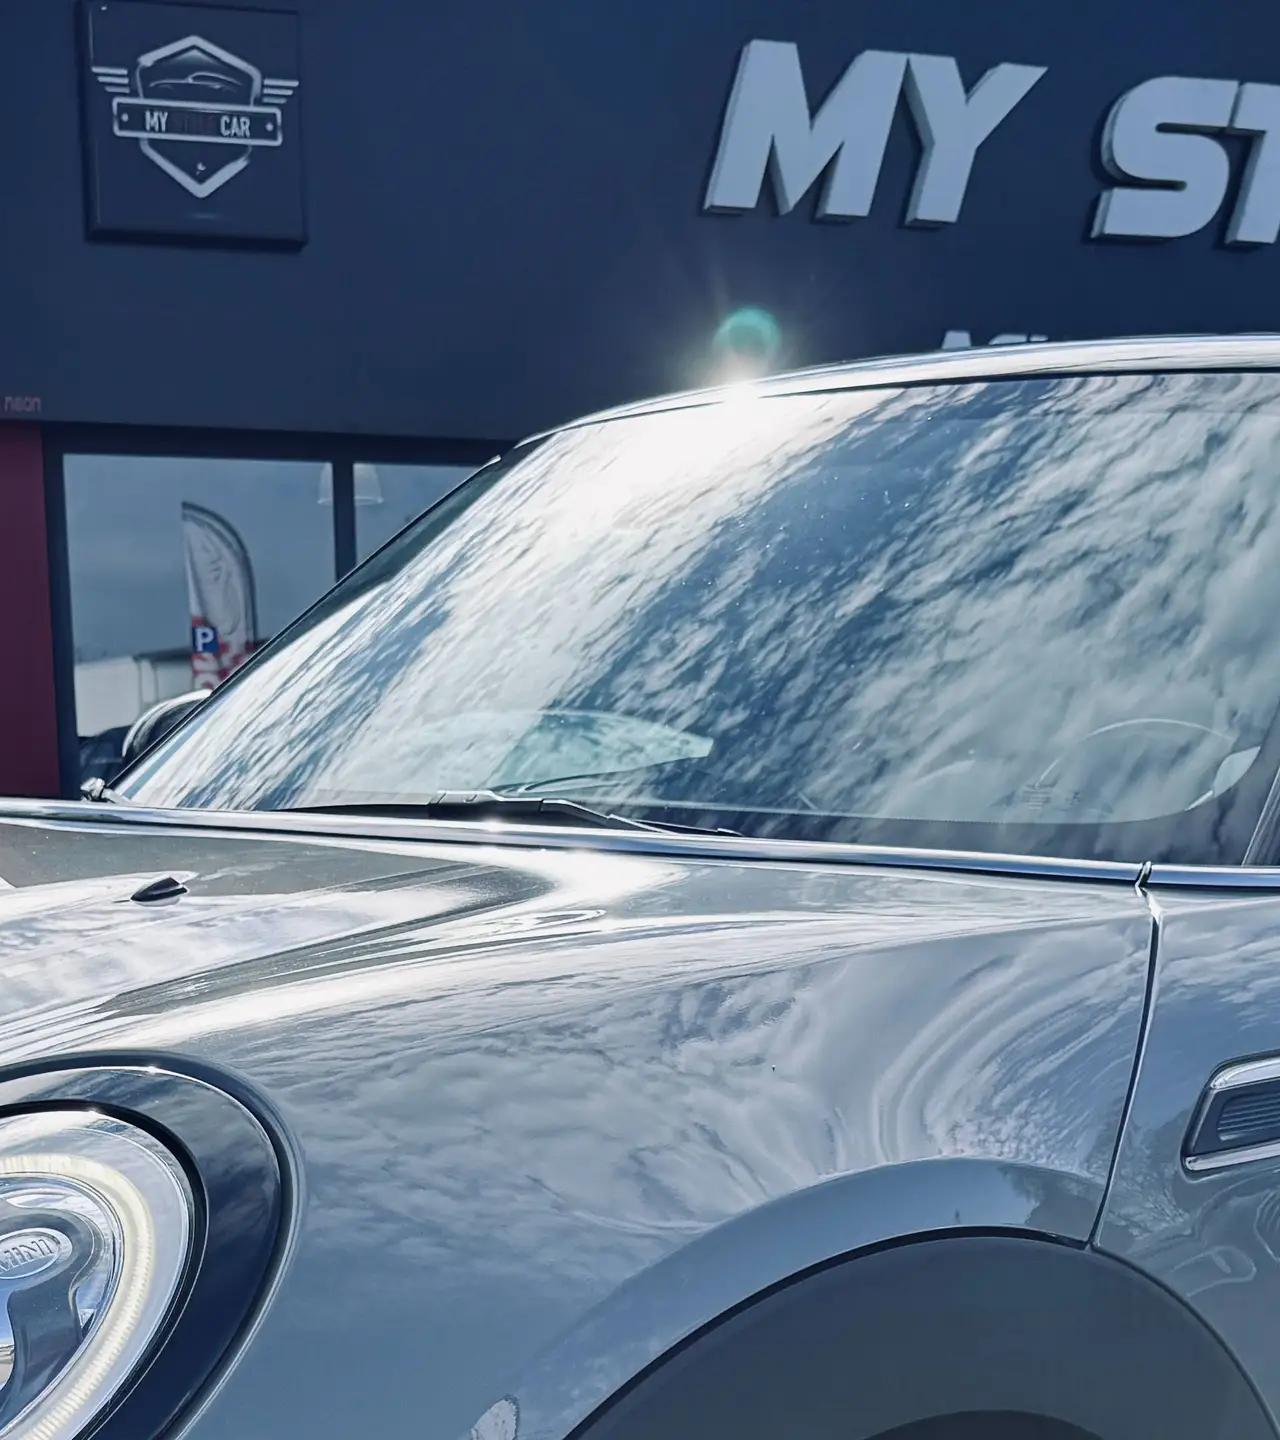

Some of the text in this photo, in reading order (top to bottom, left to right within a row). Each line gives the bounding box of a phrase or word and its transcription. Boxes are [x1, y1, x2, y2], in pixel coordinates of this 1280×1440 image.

[144, 110, 169, 132] MY
[220, 115, 251, 138] CAR
[704, 38, 1049, 225] MY
[194, 626, 215, 652] P
